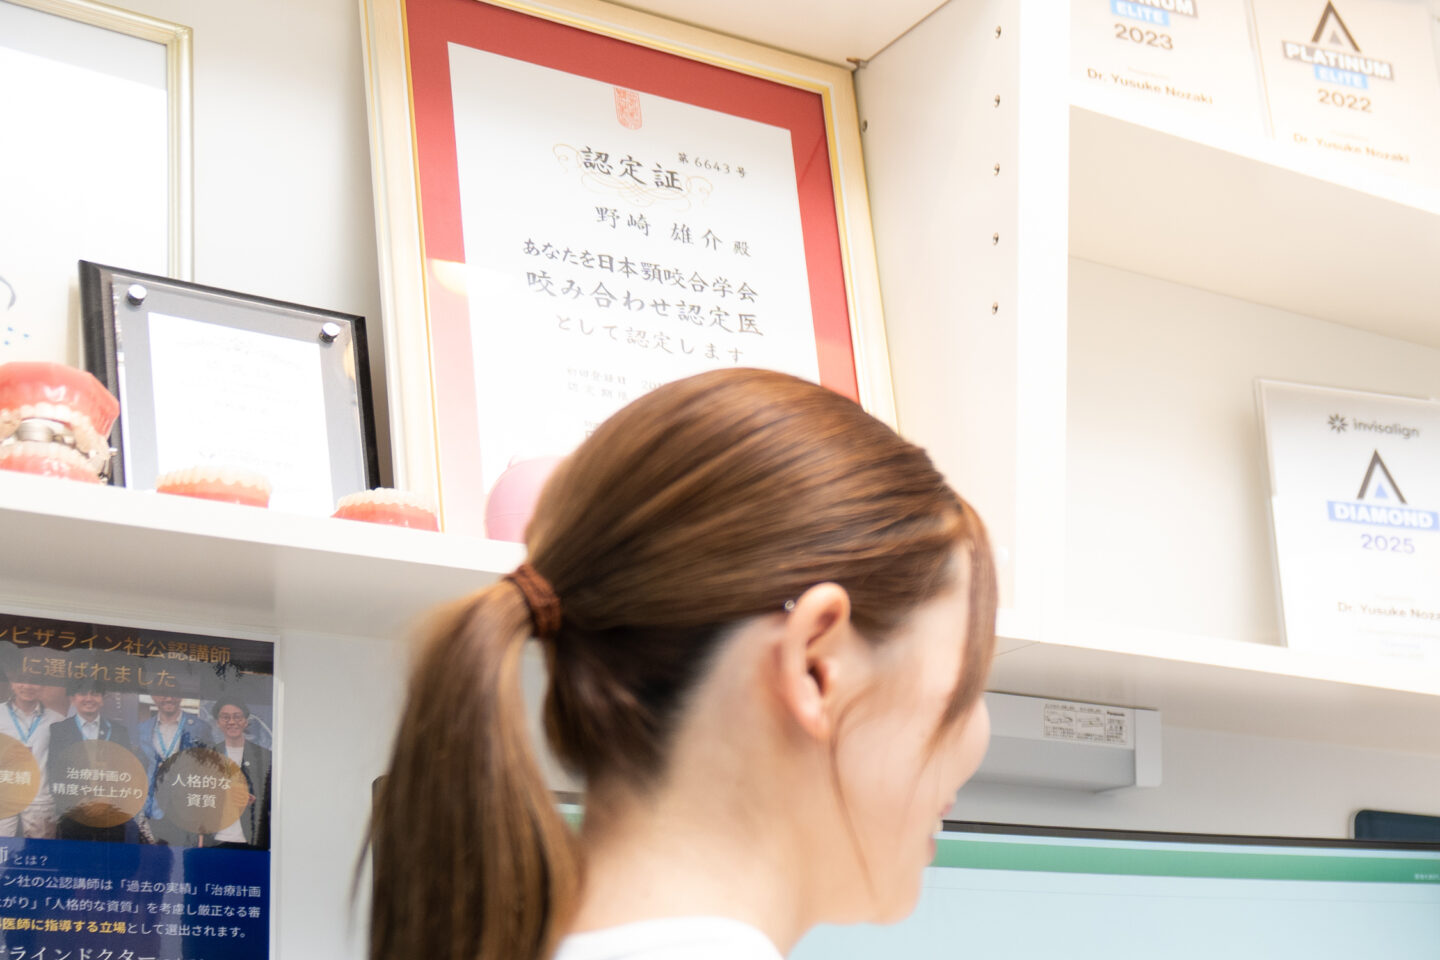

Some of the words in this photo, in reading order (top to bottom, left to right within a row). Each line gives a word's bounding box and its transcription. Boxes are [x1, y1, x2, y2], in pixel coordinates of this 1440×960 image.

[1116, 1, 1164, 25] ELITE
[1114, 23, 1174, 51] 2023
[1284, 41, 1392, 80] PLATINUM
[1087, 68, 1106, 81] Dr.
[1111, 73, 1162, 94] Yusuke
[1165, 85, 1214, 105] Nozaki
[1319, 65, 1364, 88] ELITE
[1318, 88, 1373, 113] 2022
[580, 145, 684, 193] 認定証
[677, 151, 747, 179] 第6643号
[595, 205, 652, 237] 野崎
[670, 222, 723, 253] 雄介
[522, 238, 759, 303] あなたを日本顎咬合学会
[525, 270, 764, 336] 咬み合わせ認定医
[556, 314, 745, 363] として認定します
[1352, 417, 1420, 439] invisalign
[1334, 503, 1435, 530] DIAMOND
[1360, 533, 1416, 555] 2025
[1360, 603, 1407, 617] Yusuke
[22, 656, 177, 688] に選ばれました
[66, 767, 132, 784] 治療計画の
[171, 773, 232, 790] 人格的な
[52, 782, 144, 800] 精度や仕上がり
[185, 793, 217, 809] 資質
[0, 896, 261, 919] がり」「人格的な資質」を考慮し厳正なる審
[0, 916, 247, 938] 医師に指導する立場として選出されます。
